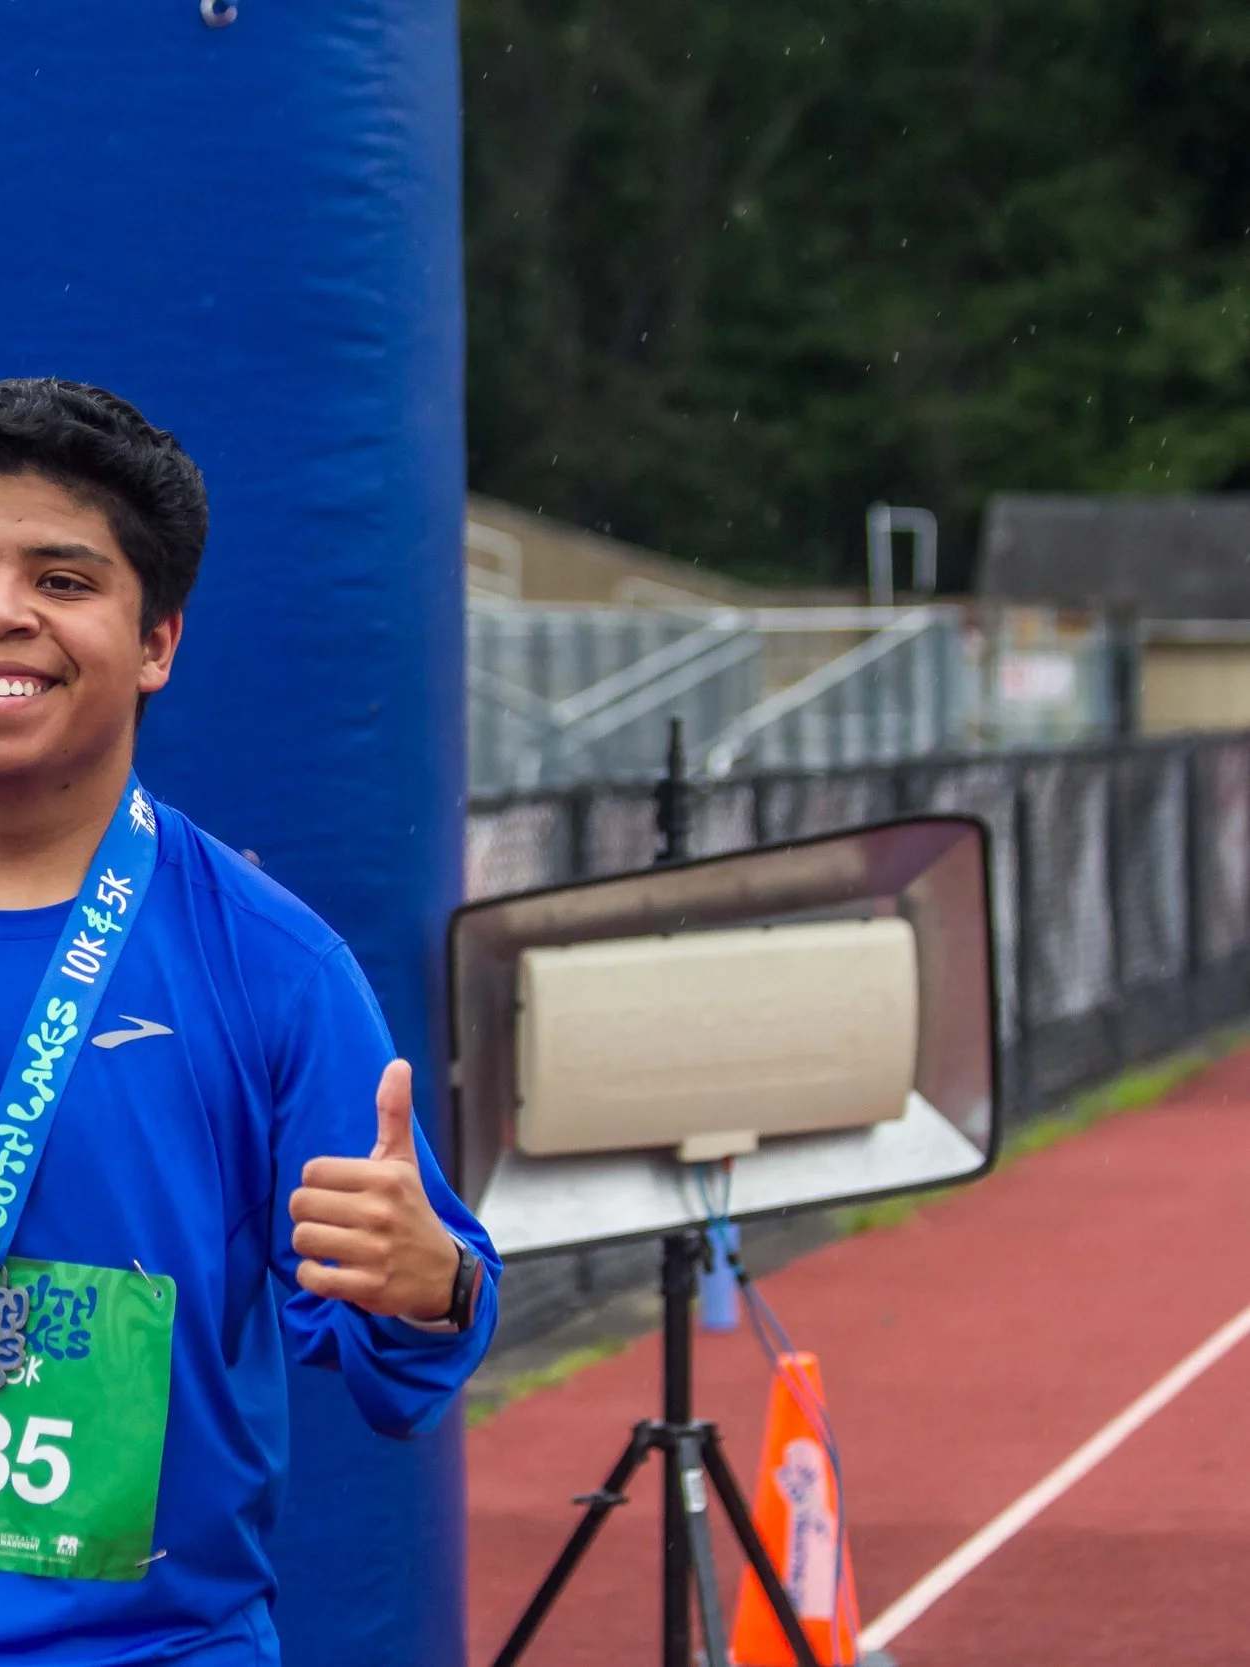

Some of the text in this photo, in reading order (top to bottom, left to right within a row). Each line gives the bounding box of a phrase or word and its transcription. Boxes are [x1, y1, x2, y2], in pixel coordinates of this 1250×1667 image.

[99, 868, 132, 914] 5K
[82, 906, 123, 933] &
[61, 931, 106, 984] 10K
[8, 997, 78, 1121] LAKES
[26, 1274, 98, 1327] UTH
[24, 1314, 91, 1361] KES
